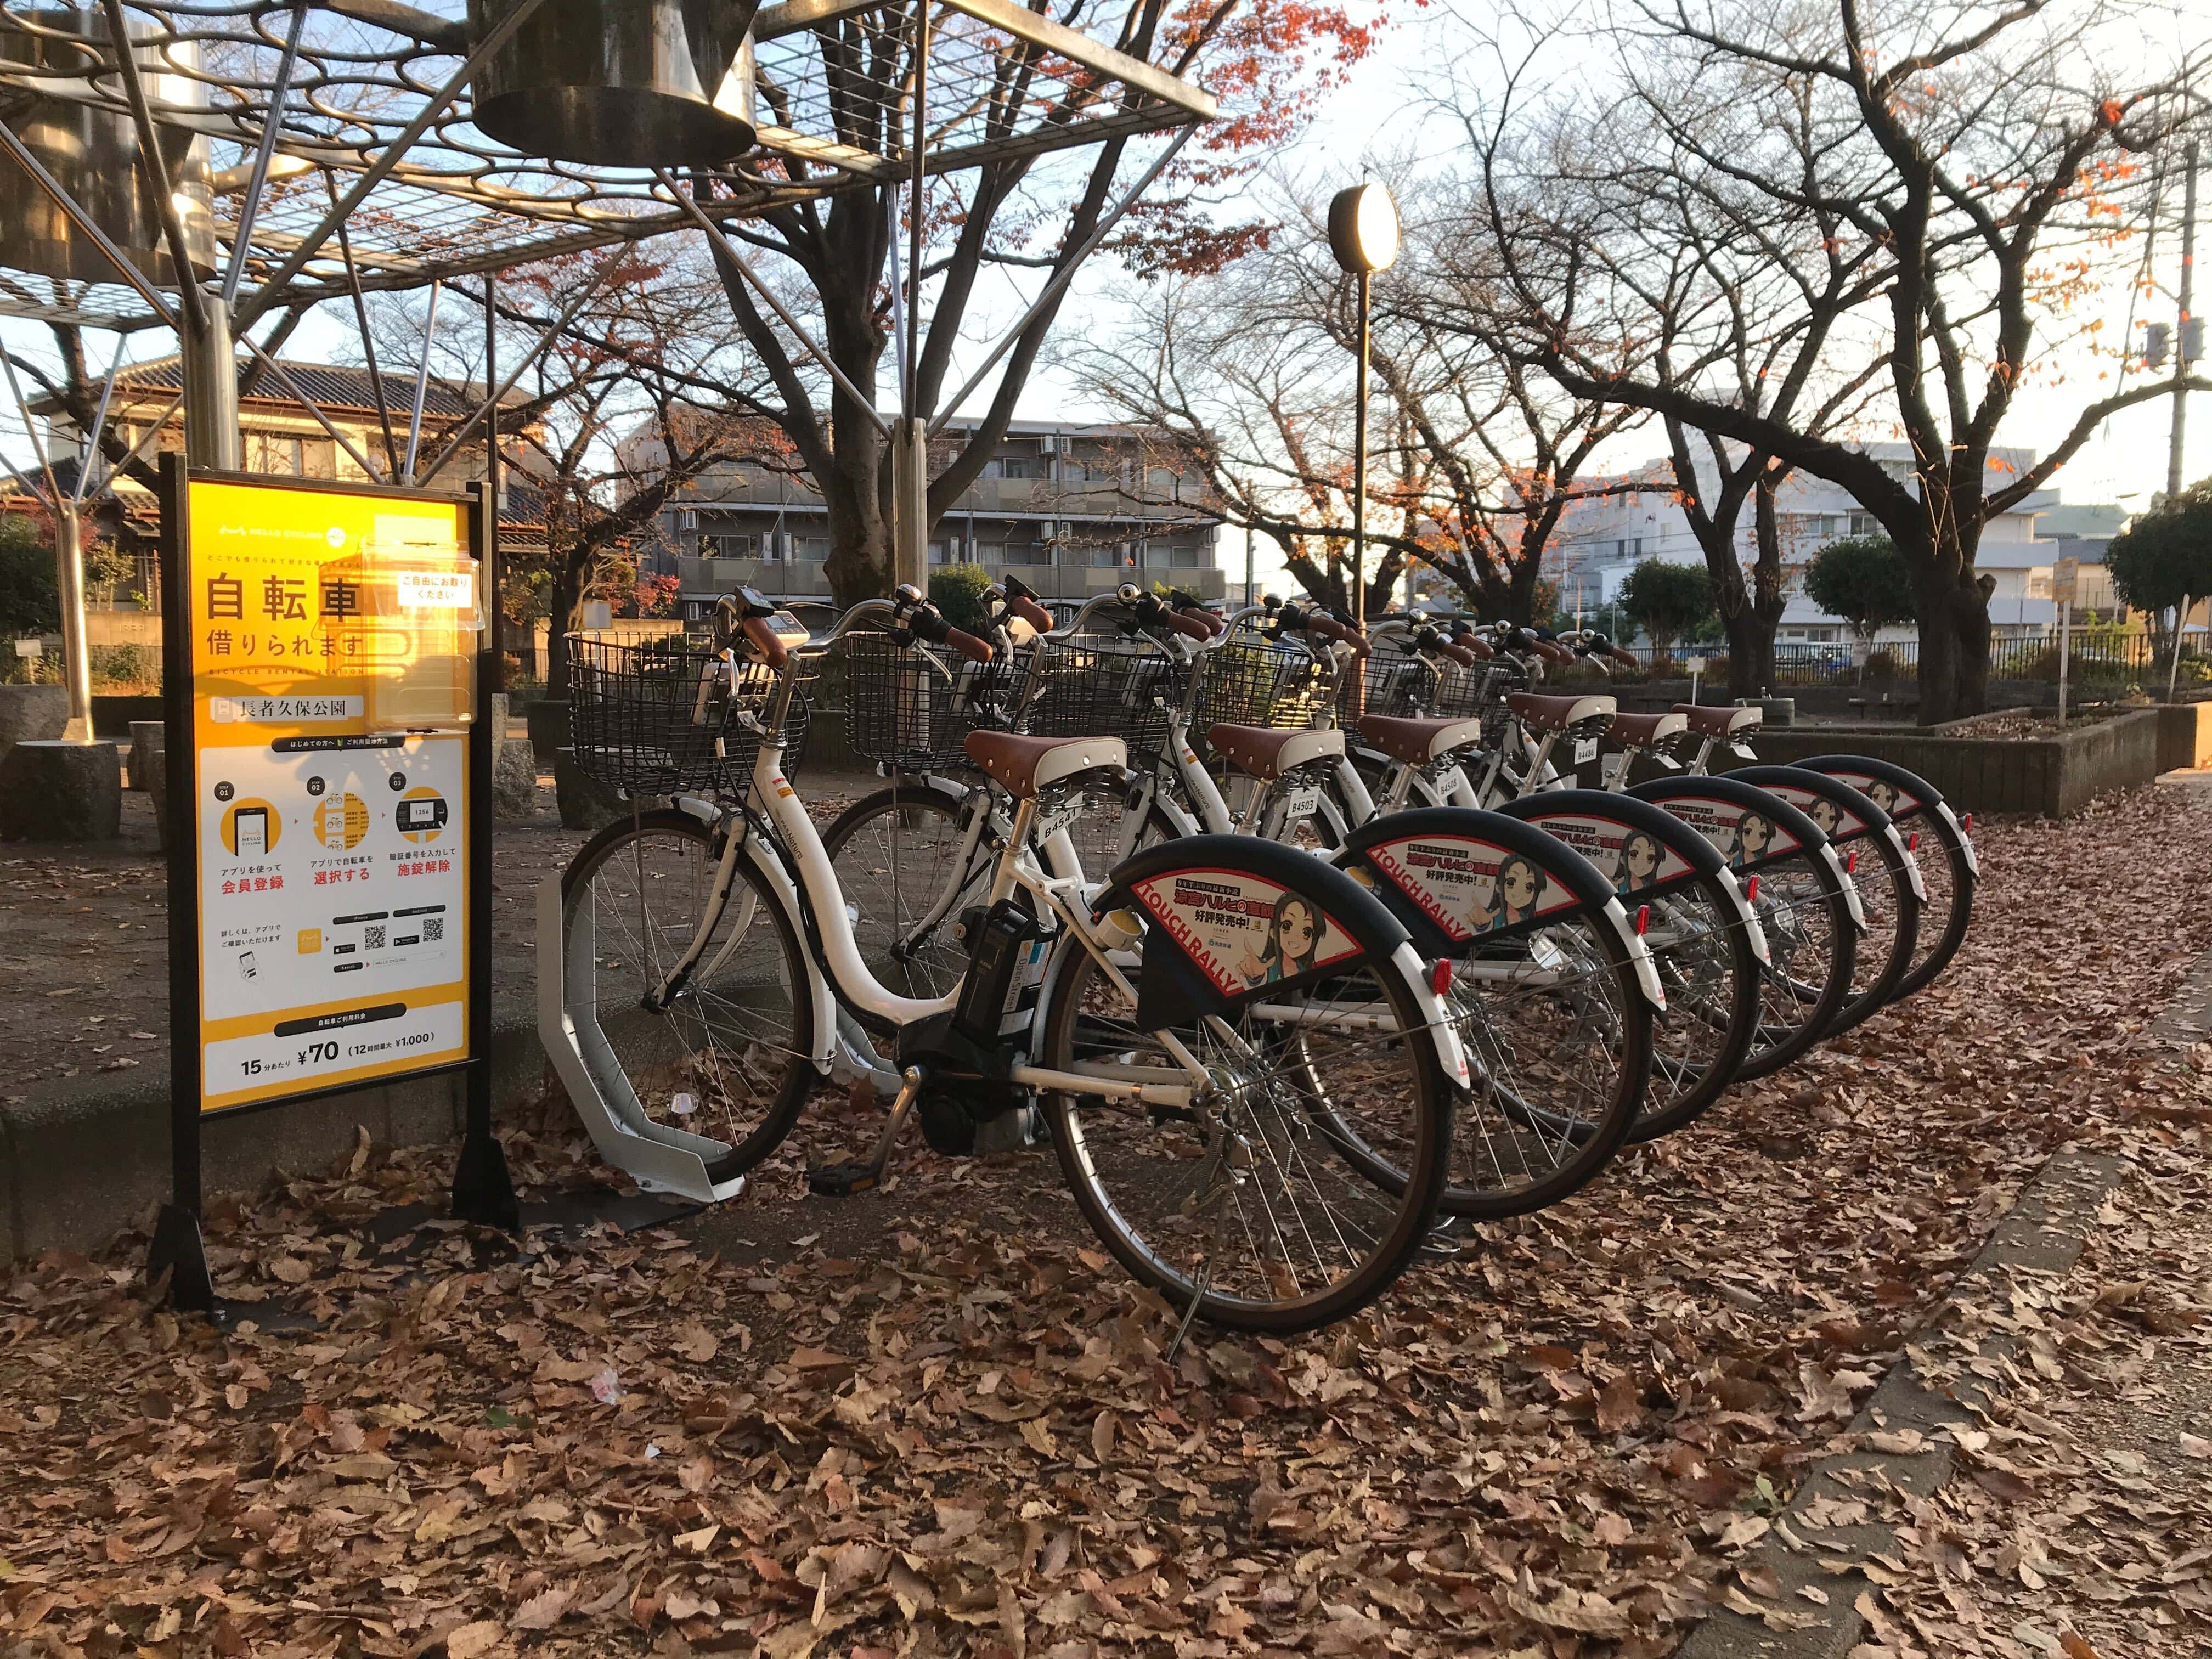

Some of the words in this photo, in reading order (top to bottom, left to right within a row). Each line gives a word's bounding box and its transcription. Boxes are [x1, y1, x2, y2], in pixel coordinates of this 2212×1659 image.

[403, 576, 467, 588] ご自由にお取り
[208, 572, 362, 622] 自転車
[418, 590, 454, 599] ください
[206, 629, 363, 657] 借りられます
[240, 699, 346, 717] 長者久保公園
[1578, 748, 1594, 760] B4486
[1441, 778, 1457, 795] B4508
[1292, 800, 1314, 812] B4503
[1045, 808, 1075, 838] B4541
[221, 864, 281, 877] アプリを使って
[311, 856, 374, 868] アプリで自転車を
[398, 859, 450, 877] 施錠解除
[314, 867, 370, 885] 選択する
[221, 876, 284, 895] 会員登録
[1376, 848, 1423, 900] TOUCH
[1420, 891, 1466, 935] RALLY
[222, 935, 281, 947] ご確認いただけます
[1141, 882, 1192, 941] TOUCH
[1188, 936, 1238, 991] RALLY
[1006, 958, 1028, 1010] OpenStreet
[298, 1041, 339, 1065] ¥70
